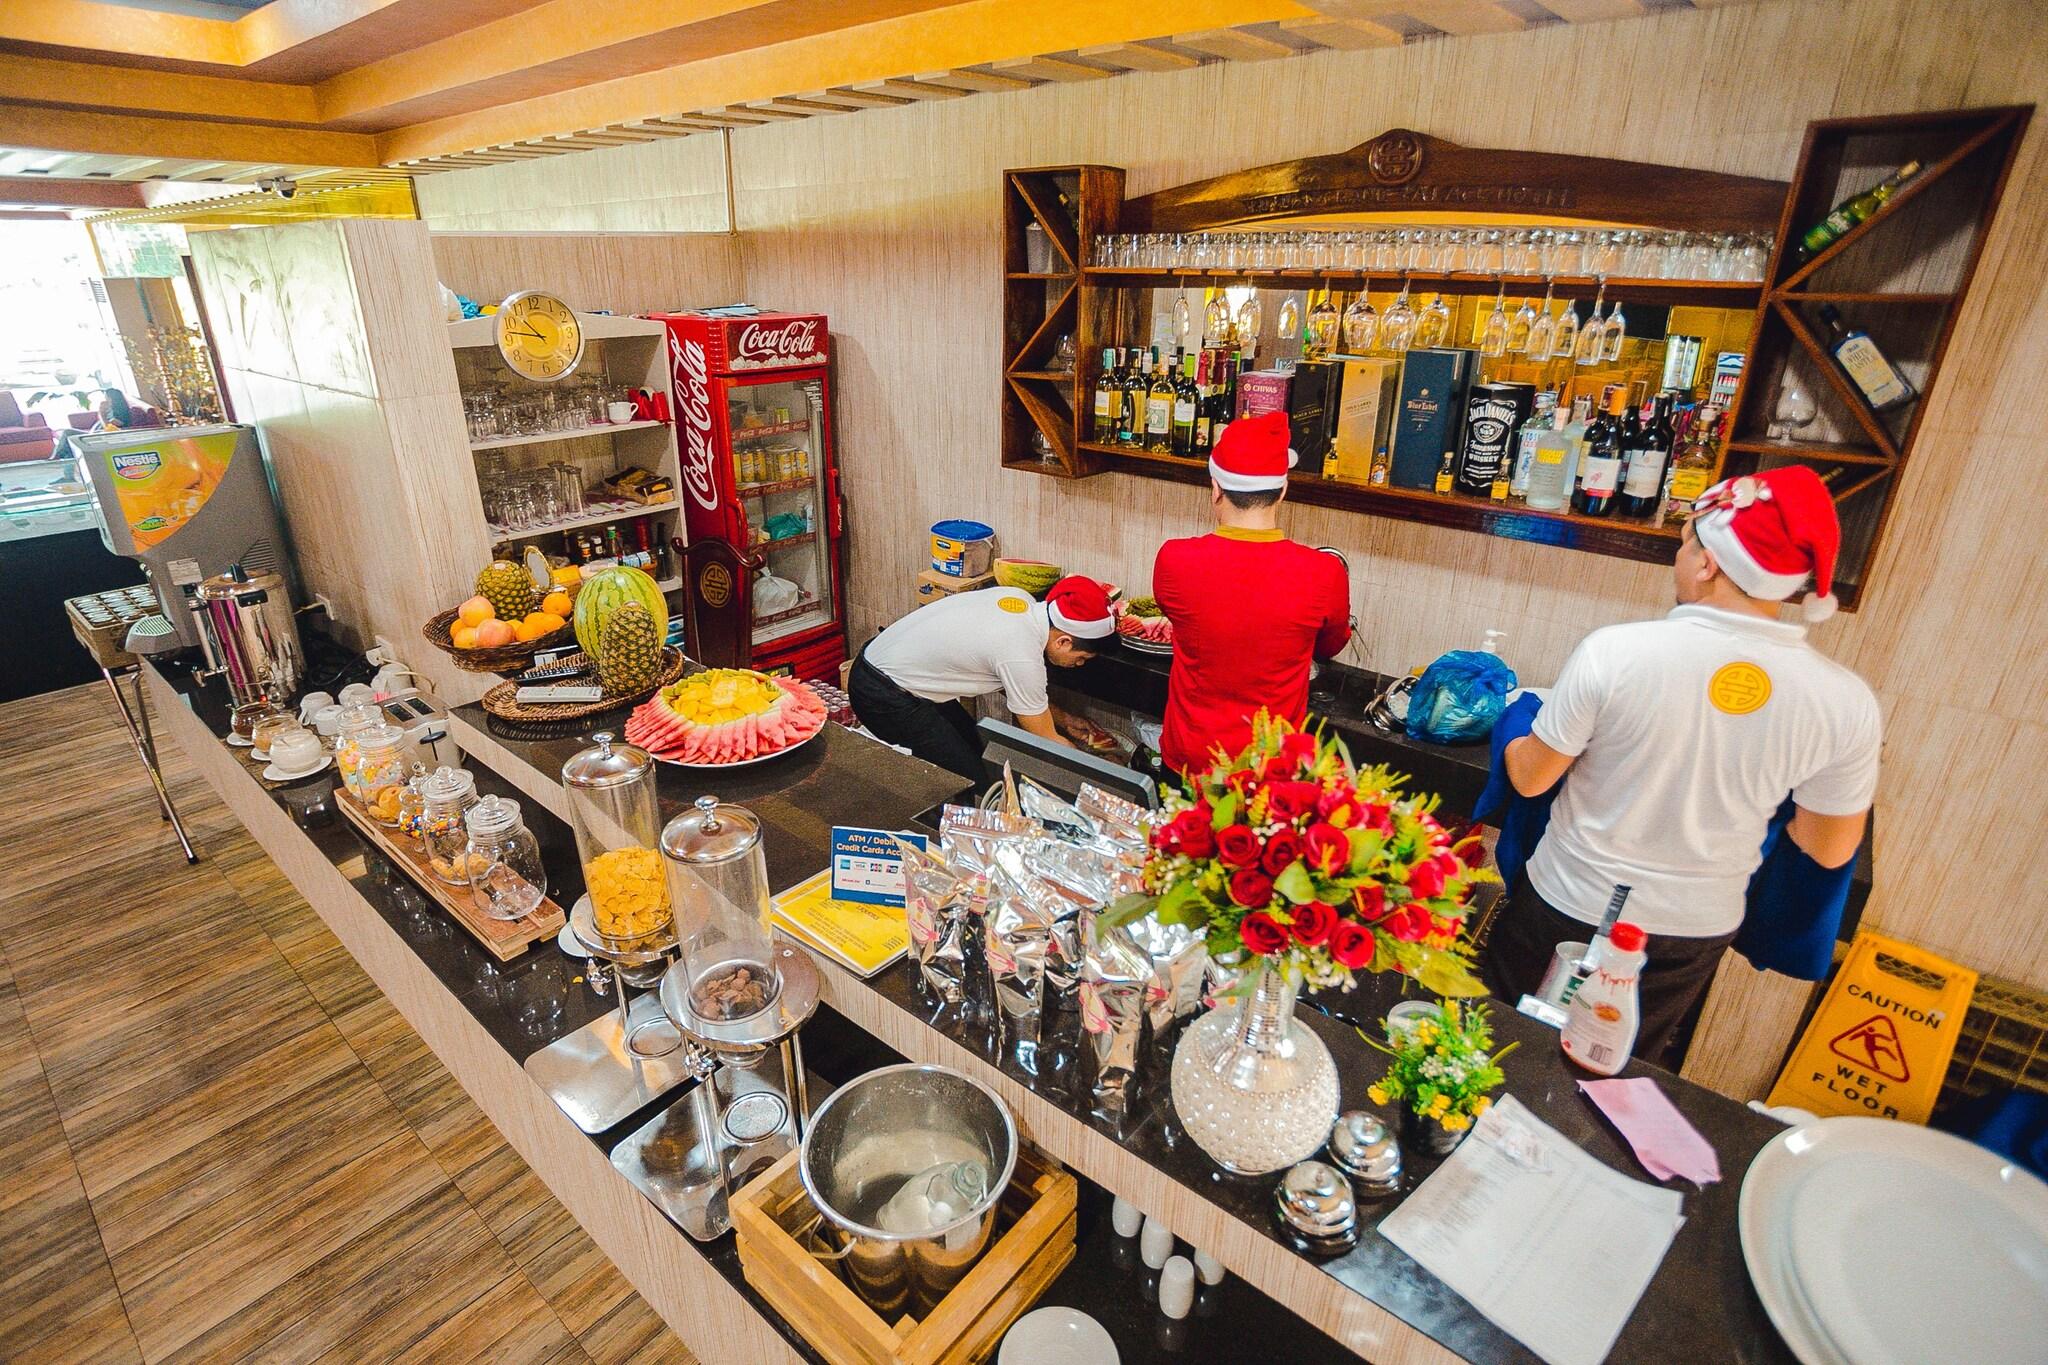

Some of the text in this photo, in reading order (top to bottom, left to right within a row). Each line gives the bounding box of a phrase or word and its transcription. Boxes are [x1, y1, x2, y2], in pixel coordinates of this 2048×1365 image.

[513, 303, 524, 316] 11
[528, 297, 540, 310] 12
[548, 300, 553, 313] 1
[504, 316, 516, 329] 10
[560, 311, 567, 323] 2
[566, 327, 573, 339] 3
[738, 320, 818, 357] Coca-Cola
[505, 333, 513, 347] 9
[513, 349, 521, 362] 8
[565, 343, 573, 355] 4
[527, 360, 533, 372] 7
[543, 361, 550, 374] 6
[557, 355, 564, 368] 5
[1253, 384, 1277, 393] CHIVAS
[669, 326, 718, 511] Coca-Cola
[1469, 405, 1485, 422] JACK
[848, 835, 865, 843] ATM
[873, 837, 895, 846] Debit
[836, 843, 860, 852] Credit
[861, 845, 884, 855] Cards
[1847, 983, 1941, 1030] CAUTION
[1836, 1064, 1888, 1095] WET
[1811, 1072, 1899, 1120] FLOOR
